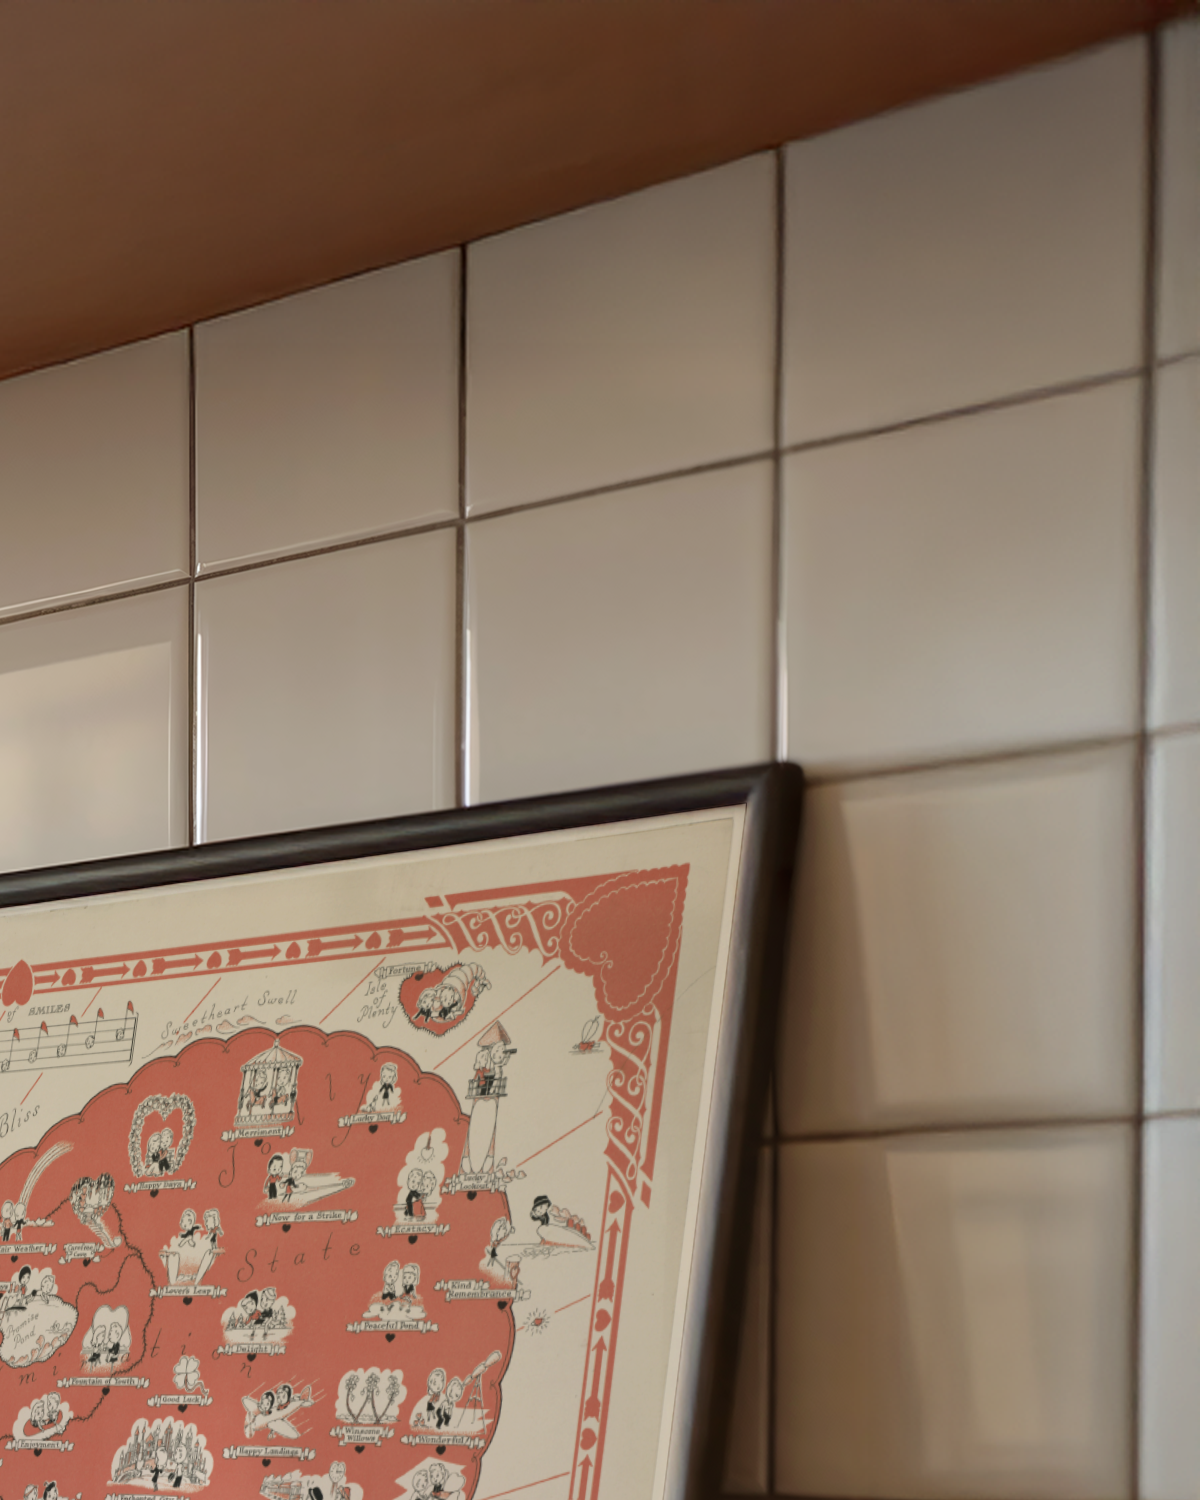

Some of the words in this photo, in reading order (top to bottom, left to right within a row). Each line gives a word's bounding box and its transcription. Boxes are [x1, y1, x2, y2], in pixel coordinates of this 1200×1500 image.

[388, 965, 421, 975] Fortune
[364, 981, 387, 996] Isle
[373, 990, 388, 1005] of
[7, 1006, 19, 1023] of
[28, 1003, 71, 1016] SMILES
[161, 997, 248, 1040] Sweetheart
[257, 989, 297, 1006] Swell
[357, 1005, 398, 1028] Plenty
[352, 1114, 374, 1123] Lucky
[377, 1113, 392, 1123] Dog
[238, 1128, 281, 1137] Merriment
[140, 1181, 161, 1190] Happy
[163, 1181, 182, 1189] Days
[316, 1211, 342, 1220] Strike
[395, 1225, 435, 1234] Ecstacy
[14, 1244, 44, 1253] Weather
[237, 1231, 361, 1282] State
[451, 1281, 472, 1289] Kind
[193, 1287, 211, 1296] Leap
[449, 1290, 512, 1298] Remembrance
[6, 1313, 40, 1338] Promise
[364, 1322, 397, 1330] Peaceful
[400, 1322, 419, 1330] Pond
[14, 1329, 35, 1349] Pond
[236, 1345, 268, 1353] Delight
[347, 1434, 376, 1442] Willows
[20, 1441, 60, 1449] Enjoyment
[239, 1448, 261, 1456] Happy
